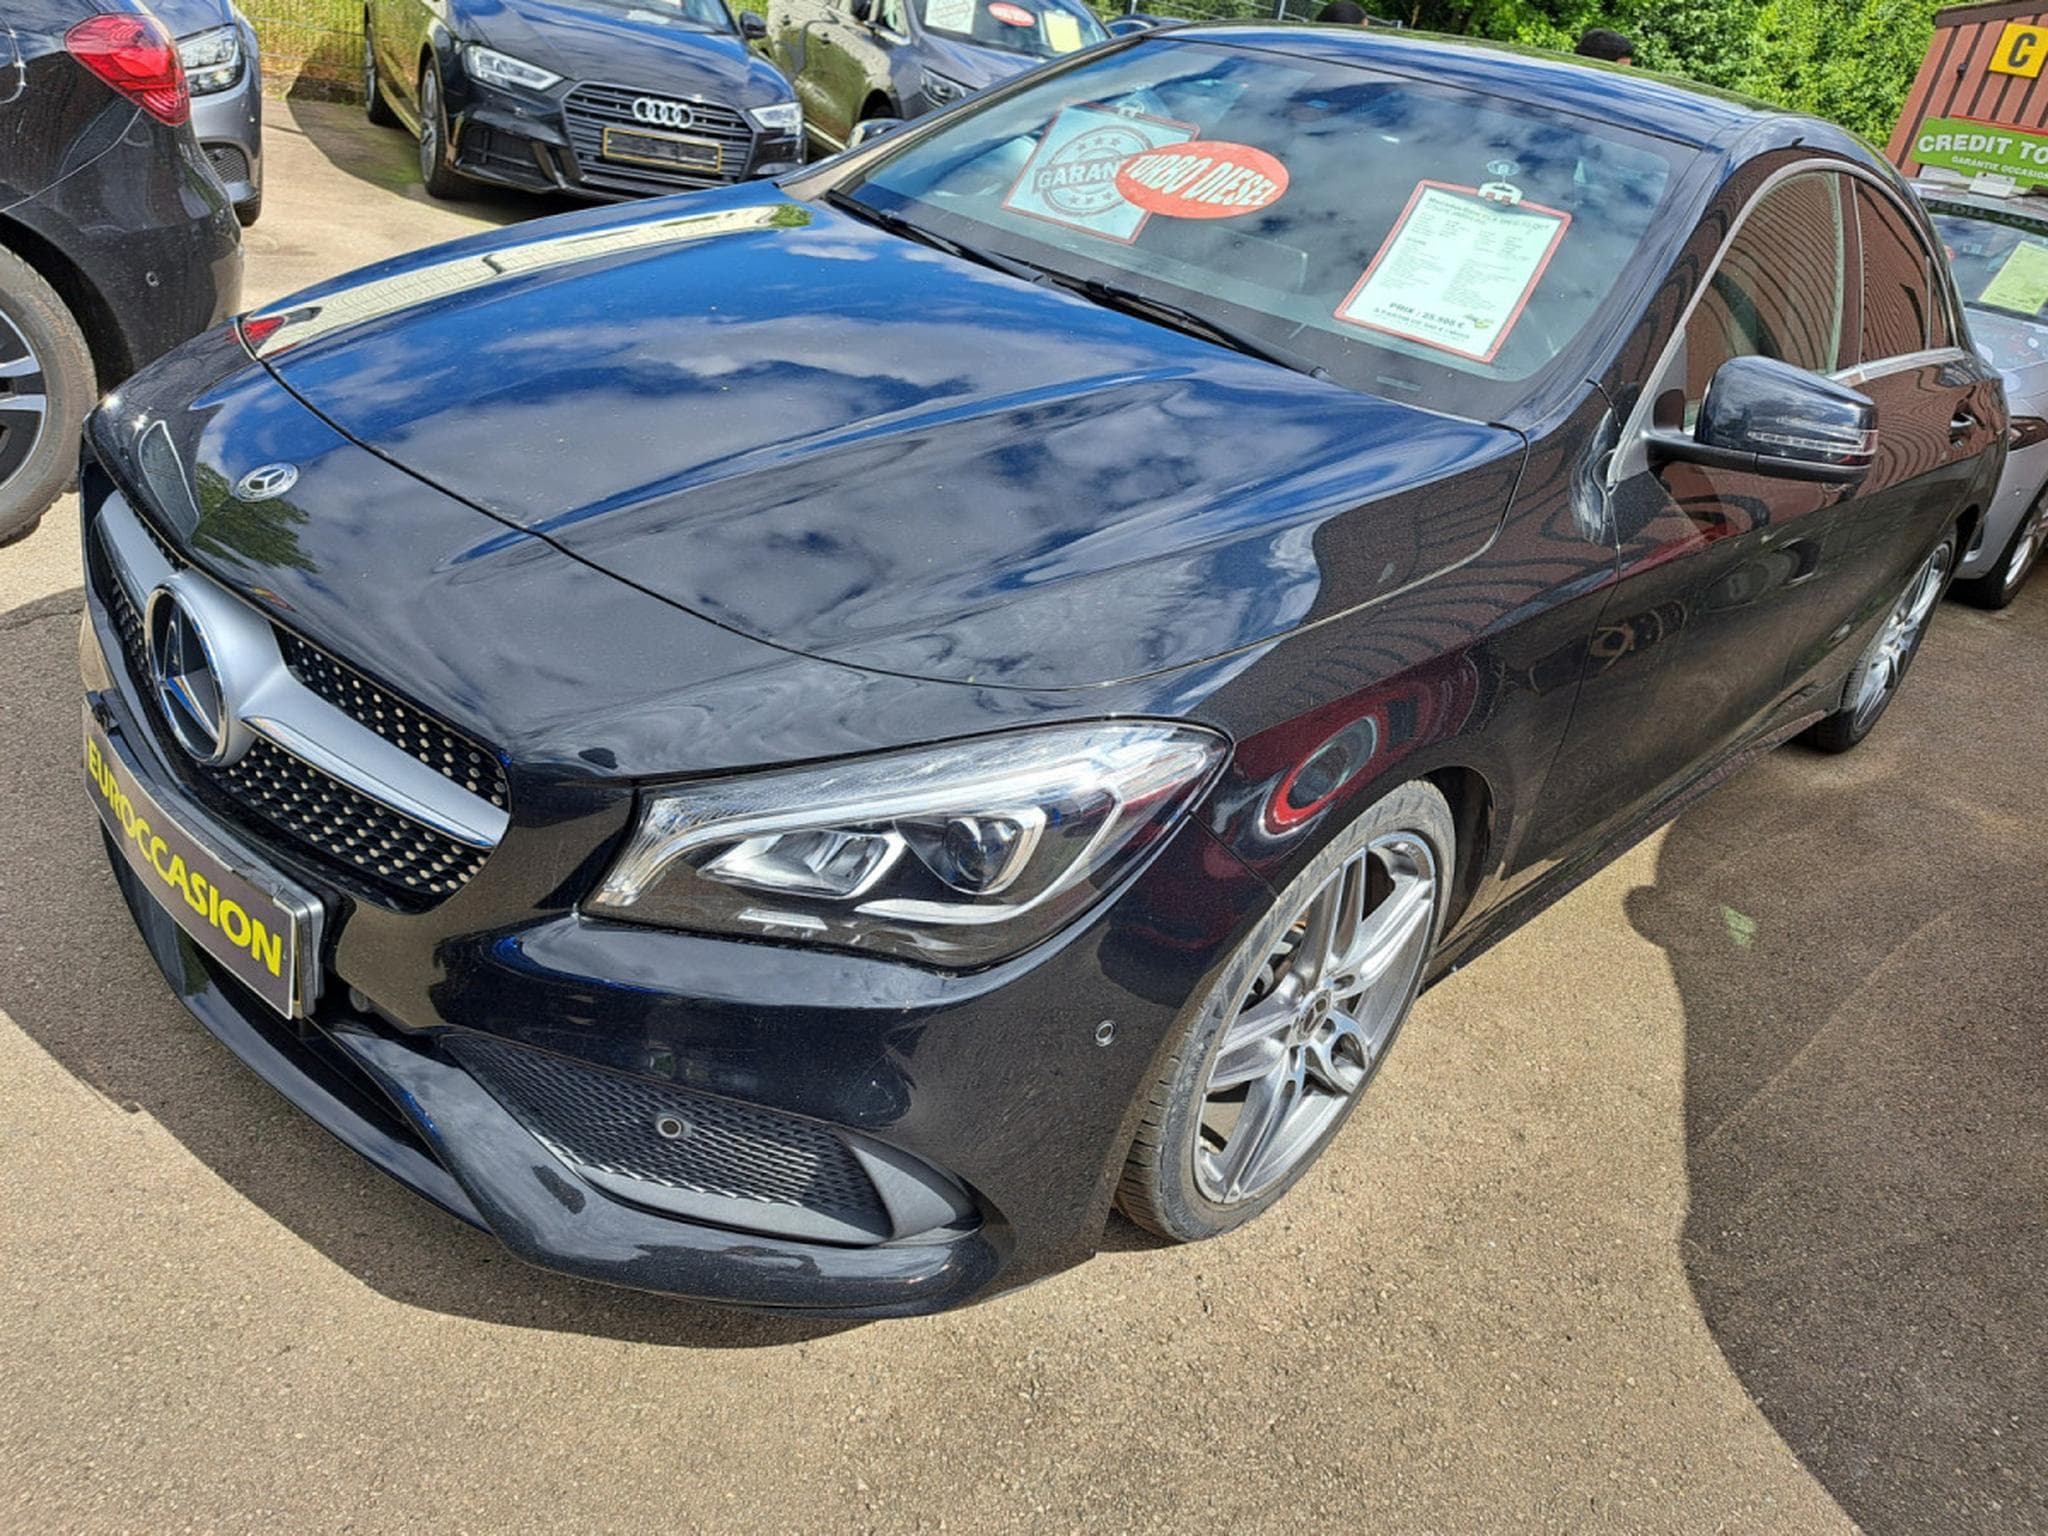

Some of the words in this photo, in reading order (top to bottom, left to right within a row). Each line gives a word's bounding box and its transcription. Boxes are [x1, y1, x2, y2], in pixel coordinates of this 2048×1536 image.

[2008, 32, 2037, 67] C
[1918, 134, 2013, 155] CREDIT
[1040, 161, 1122, 188] GARAN
[1125, 154, 1213, 194] TURBO
[1180, 162, 1278, 206] DIESEL
[88, 735, 282, 977] EUROCCASION
